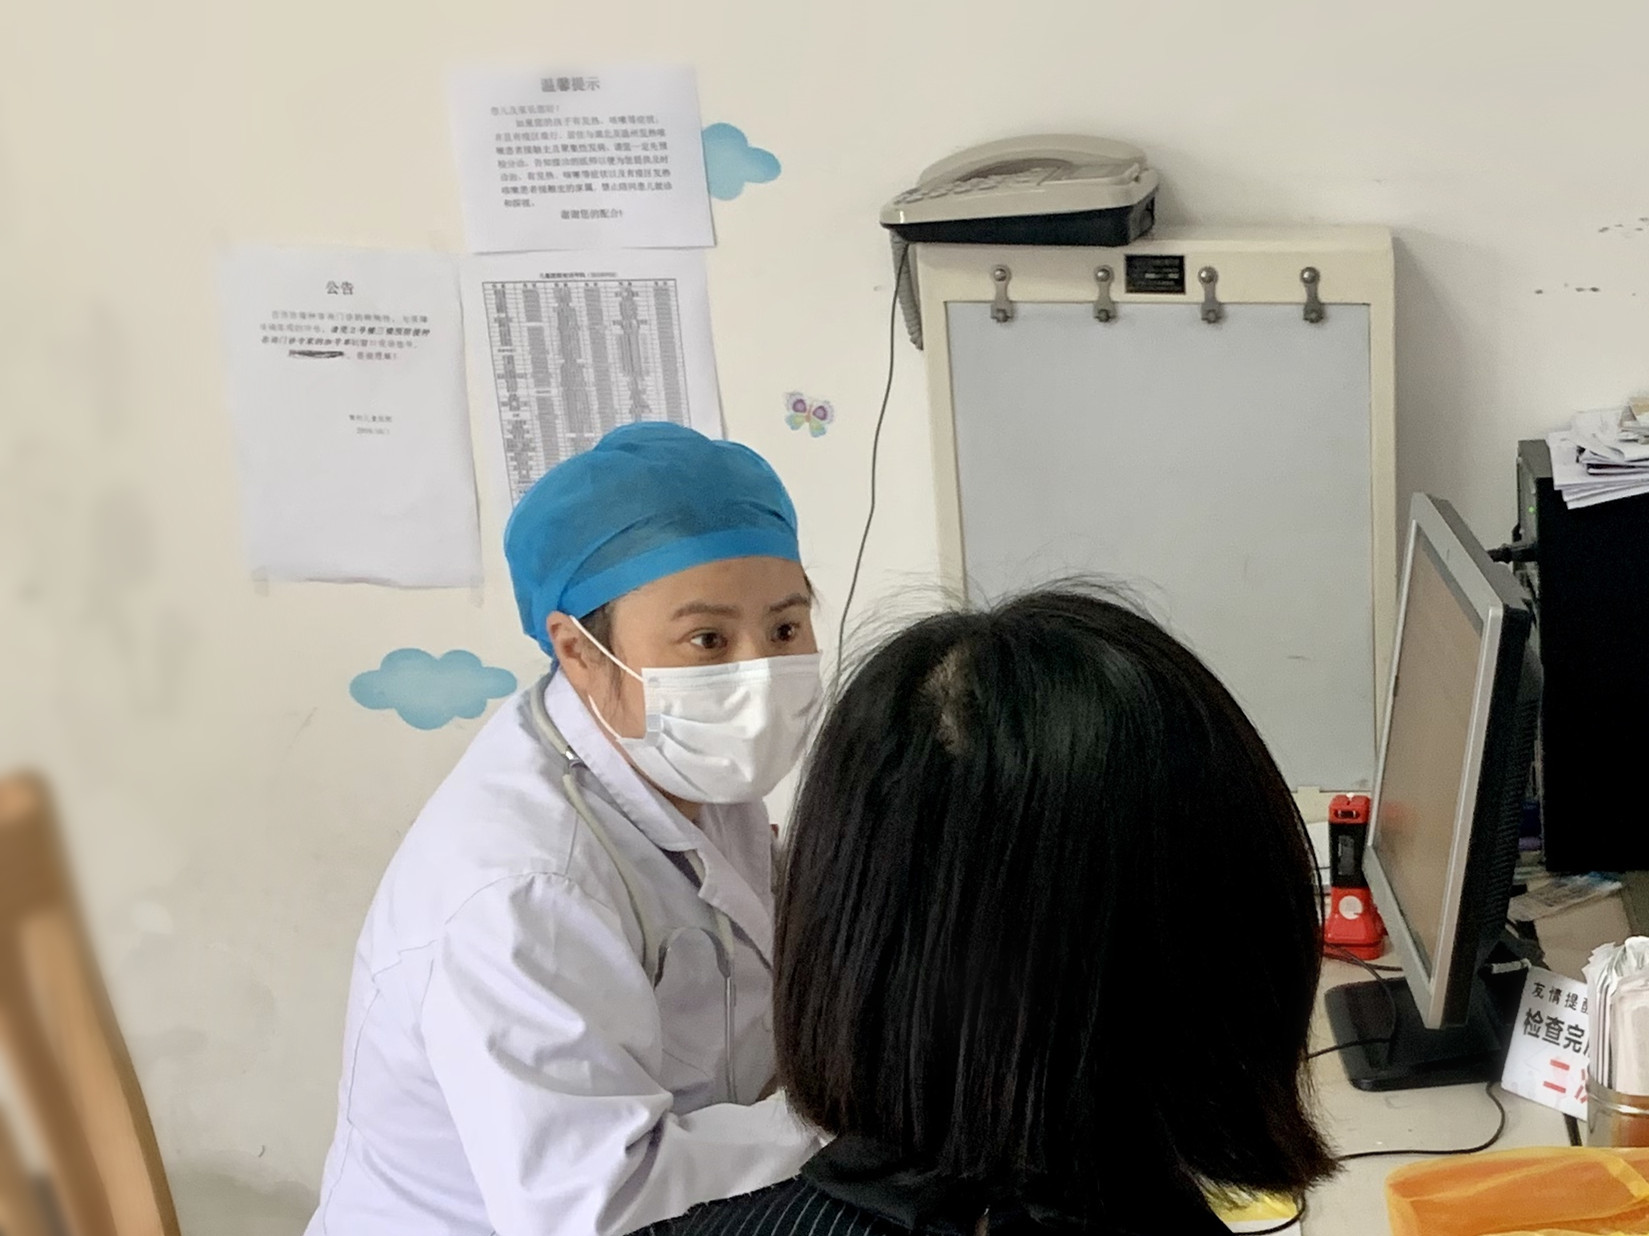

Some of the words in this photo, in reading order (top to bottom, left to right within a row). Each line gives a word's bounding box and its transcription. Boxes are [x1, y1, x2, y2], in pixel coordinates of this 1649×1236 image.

[541, 76, 601, 93] 温馨提示
[326, 280, 354, 296] 公告
[1522, 1008, 1589, 1056] 检查完
